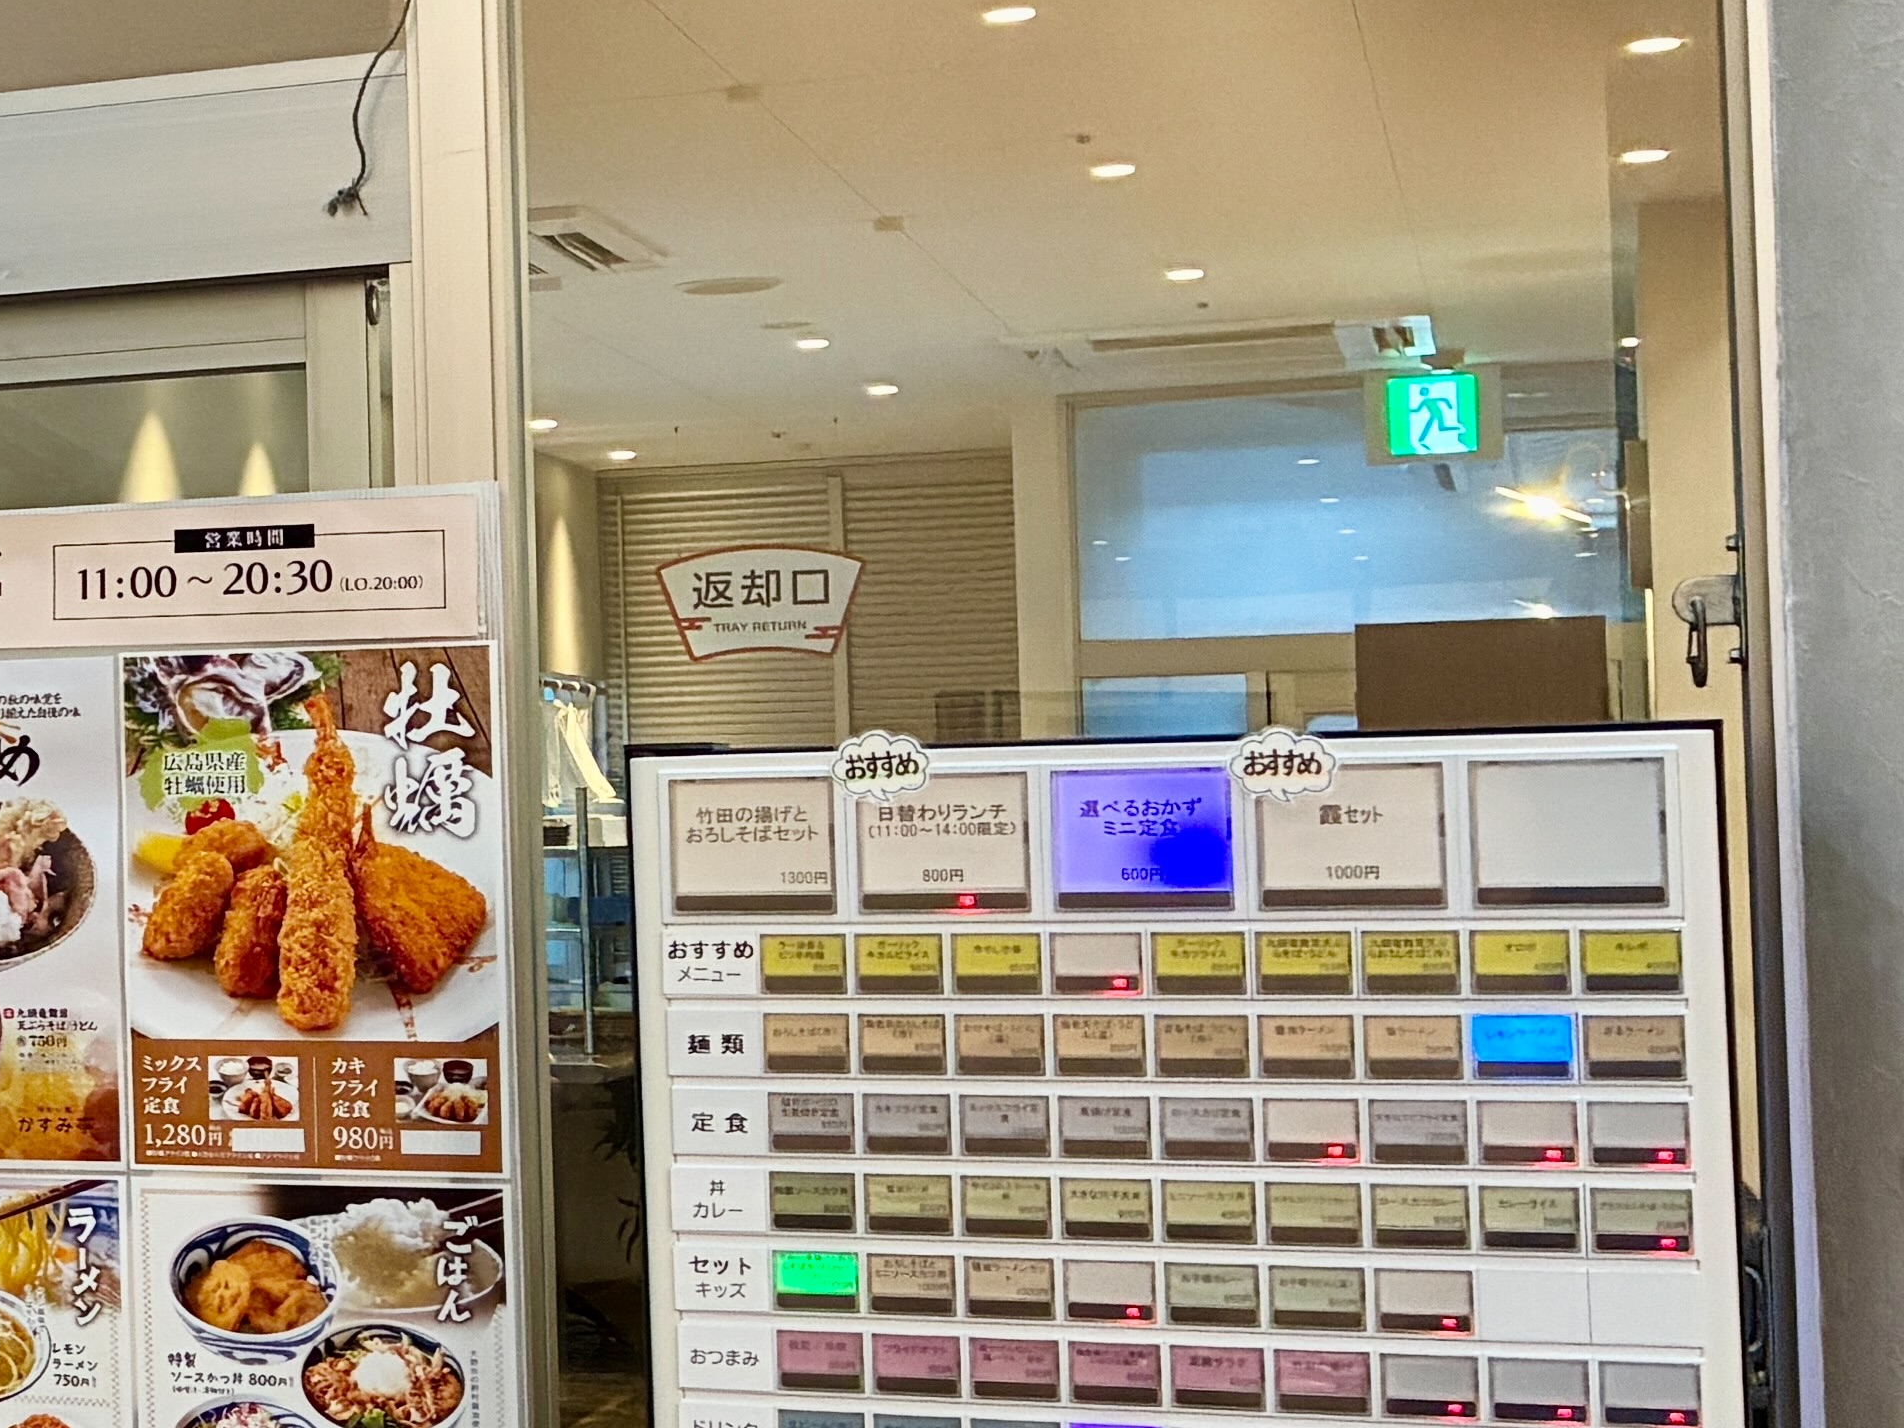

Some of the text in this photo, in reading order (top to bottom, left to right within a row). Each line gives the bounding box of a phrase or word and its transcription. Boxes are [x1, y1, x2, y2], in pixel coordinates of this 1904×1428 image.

[204, 528, 284, 549] 営業時間
[692, 568, 830, 610] 返却口
[713, 619, 808, 634] TRAY RETURN
[382, 660, 478, 840] 牡蠣
[162, 751, 247, 774] 広島県産
[843, 751, 921, 781] おすすめ
[1242, 748, 1323, 779] おすすめ
[162, 774, 247, 797] 牡蠣使用
[694, 804, 809, 825] 竹田の揚げと
[876, 802, 1008, 823] 日替わりランチ
[1079, 795, 1203, 820] 選べるおかず
[1318, 803, 1384, 826] 霞セット
[685, 824, 820, 845] おろしそばセット
[1101, 816, 1181, 840] ミニ定食
[1324, 864, 1381, 882] 1000円
[667, 939, 755, 962] おすすめ
[678, 967, 742, 984] メニュー
[687, 1032, 746, 1057] 麺類
[142, 1054, 202, 1073] ミックス
[331, 1056, 367, 1075] カキ
[141, 1075, 188, 1095] フライ
[331, 1078, 379, 1099] フライ
[143, 1096, 181, 1116] 定食
[331, 1099, 371, 1119] 定食
[691, 1111, 750, 1135] 定食
[144, 1123, 223, 1148] 1,280円
[332, 1125, 394, 1151] 980円
[708, 1179, 726, 1198] 丼
[692, 1201, 744, 1220] カレー
[67, 1205, 103, 1328] ラーメン
[437, 1215, 480, 1323] ごはん
[688, 1255, 752, 1276] セット
[694, 1281, 748, 1301] キッズ
[51, 1341, 86, 1355] レモン
[689, 1347, 761, 1368] おつまみ
[52, 1356, 99, 1372] ラーメン
[248, 1373, 288, 1388] 800円
